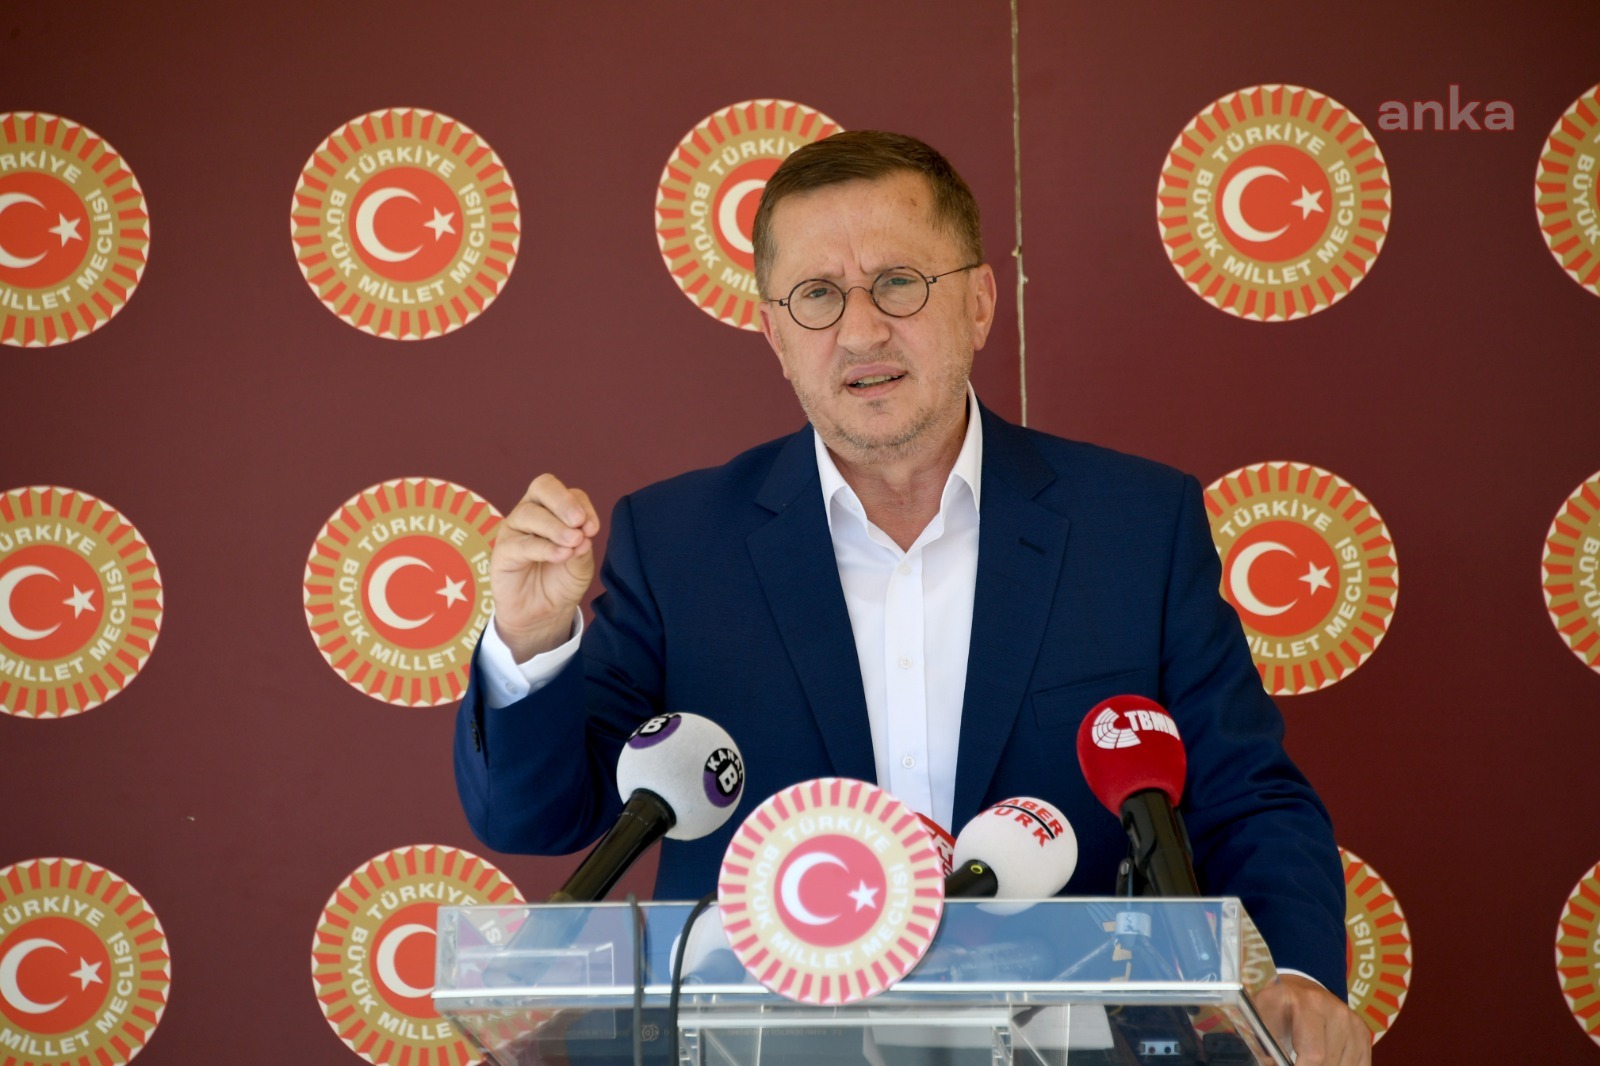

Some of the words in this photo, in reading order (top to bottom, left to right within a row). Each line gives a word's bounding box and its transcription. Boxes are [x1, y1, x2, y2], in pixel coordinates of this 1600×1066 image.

[708, 136, 803, 177] TÜRKİY
[1212, 122, 1326, 163] TÜRKİYE
[0, 149, 82, 184] RKİYE
[344, 145, 456, 185] TÜRKİYE
[690, 181, 721, 270] BÜYÜK
[720, 266, 759, 295] MİL
[1192, 168, 1224, 259] BÜYÜK
[1222, 255, 1312, 284] MİLLET
[326, 189, 359, 279] BÜYÜK
[357, 274, 446, 304] MİLLET
[0, 286, 72, 311] İLLET
[357, 514, 468, 553] TÜRKİYE
[1219, 499, 1332, 538] TÜRKİYE
[338, 557, 371, 645] BÜYÜK
[369, 642, 457, 671] MİLLET
[718, 763, 739, 793] B
[783, 815, 892, 854] TÜRKİYE
[996, 799, 1064, 838] ABER
[0, 894, 105, 936] ÜRKİYE
[366, 881, 477, 921] TÜRKİYE
[752, 845, 780, 930] BÜYÜK
[771, 931, 854, 969] MİLLET
[347, 926, 378, 1014] BÜYÜK
[377, 1011, 453, 1040] MİLLE
